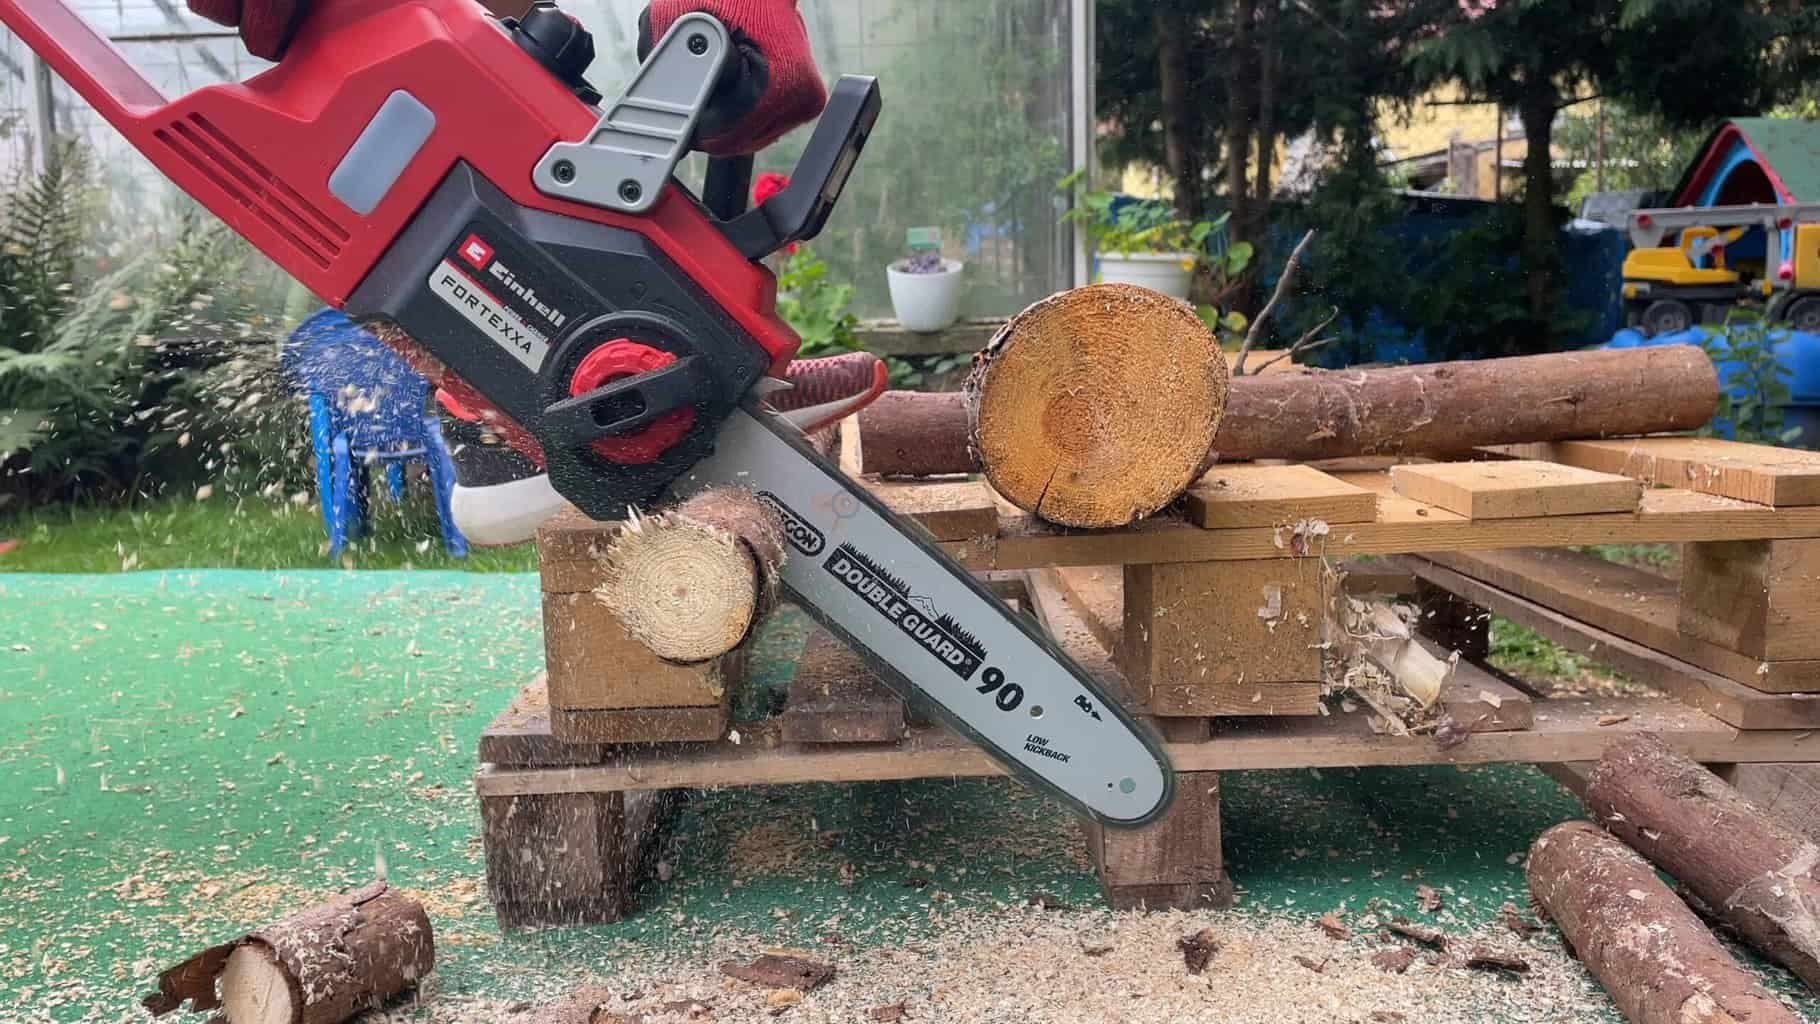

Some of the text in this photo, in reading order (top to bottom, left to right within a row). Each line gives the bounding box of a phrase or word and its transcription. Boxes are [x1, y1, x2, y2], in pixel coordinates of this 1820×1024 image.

[441, 275, 531, 354] FORTEXXA
[489, 260, 566, 328] Einhell
[832, 558, 907, 619] DOUBLE
[976, 667, 1024, 712] 90
[1023, 743, 1071, 763] KICKBACK
[1026, 734, 1049, 747] LOW
